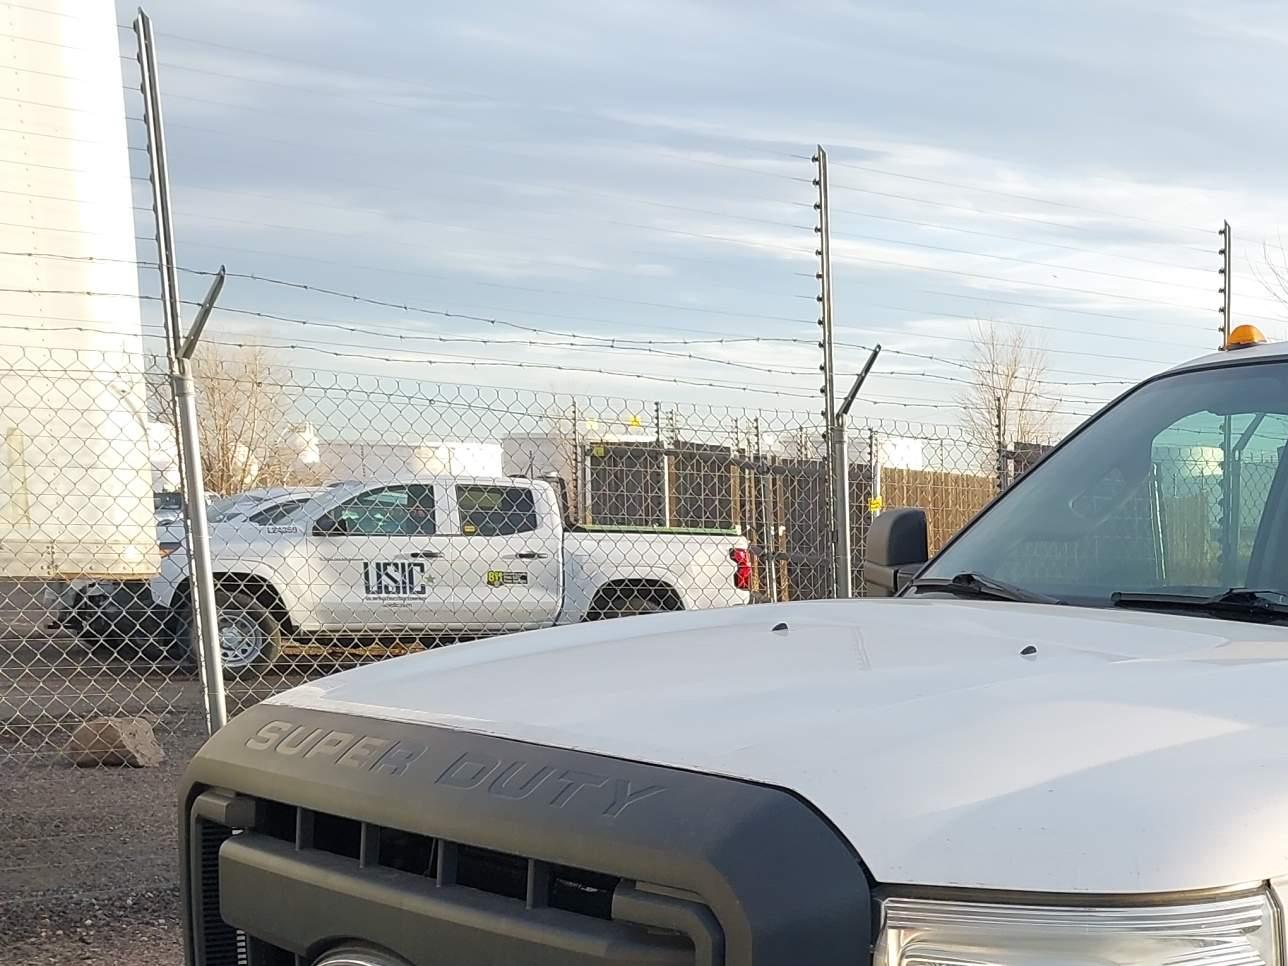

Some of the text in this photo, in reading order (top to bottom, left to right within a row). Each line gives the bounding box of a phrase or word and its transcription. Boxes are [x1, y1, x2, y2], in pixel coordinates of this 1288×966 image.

[363, 561, 427, 595] USIC
[244, 719, 667, 819] SUPER DUTY
